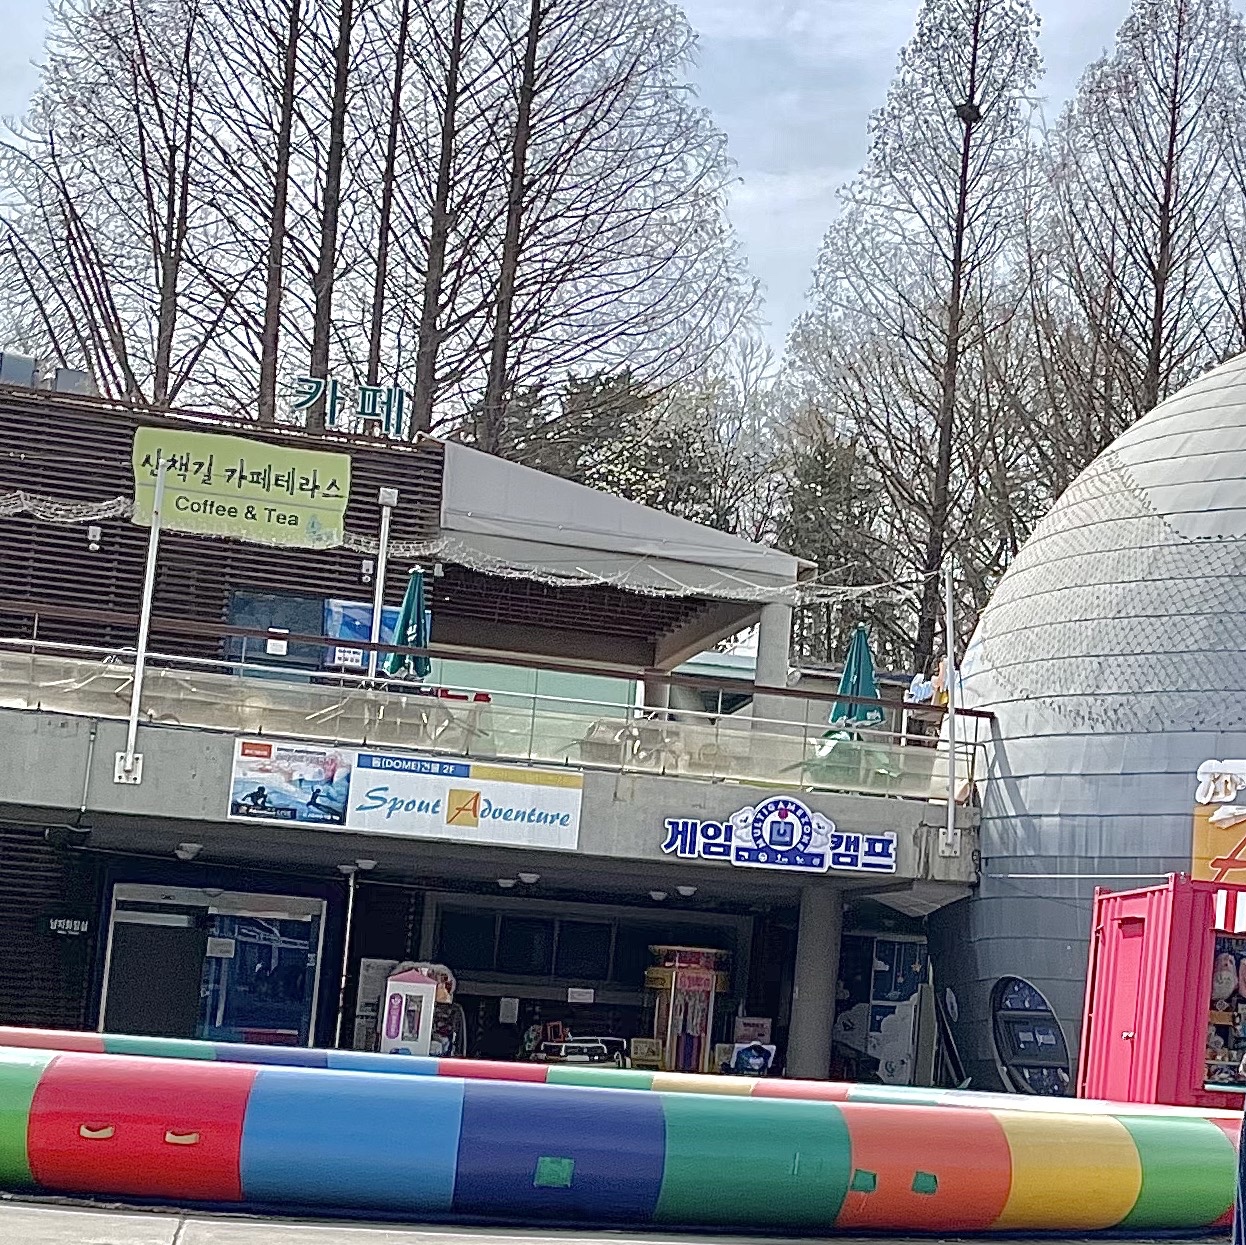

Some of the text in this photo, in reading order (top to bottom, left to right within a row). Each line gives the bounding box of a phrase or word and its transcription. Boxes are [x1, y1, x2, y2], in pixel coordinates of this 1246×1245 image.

[291, 376, 406, 436] 카페
[174, 495, 300, 527] Coffee & Tea
[355, 786, 571, 828] Spout Adventure
[664, 819, 895, 870] 게임 캠프
